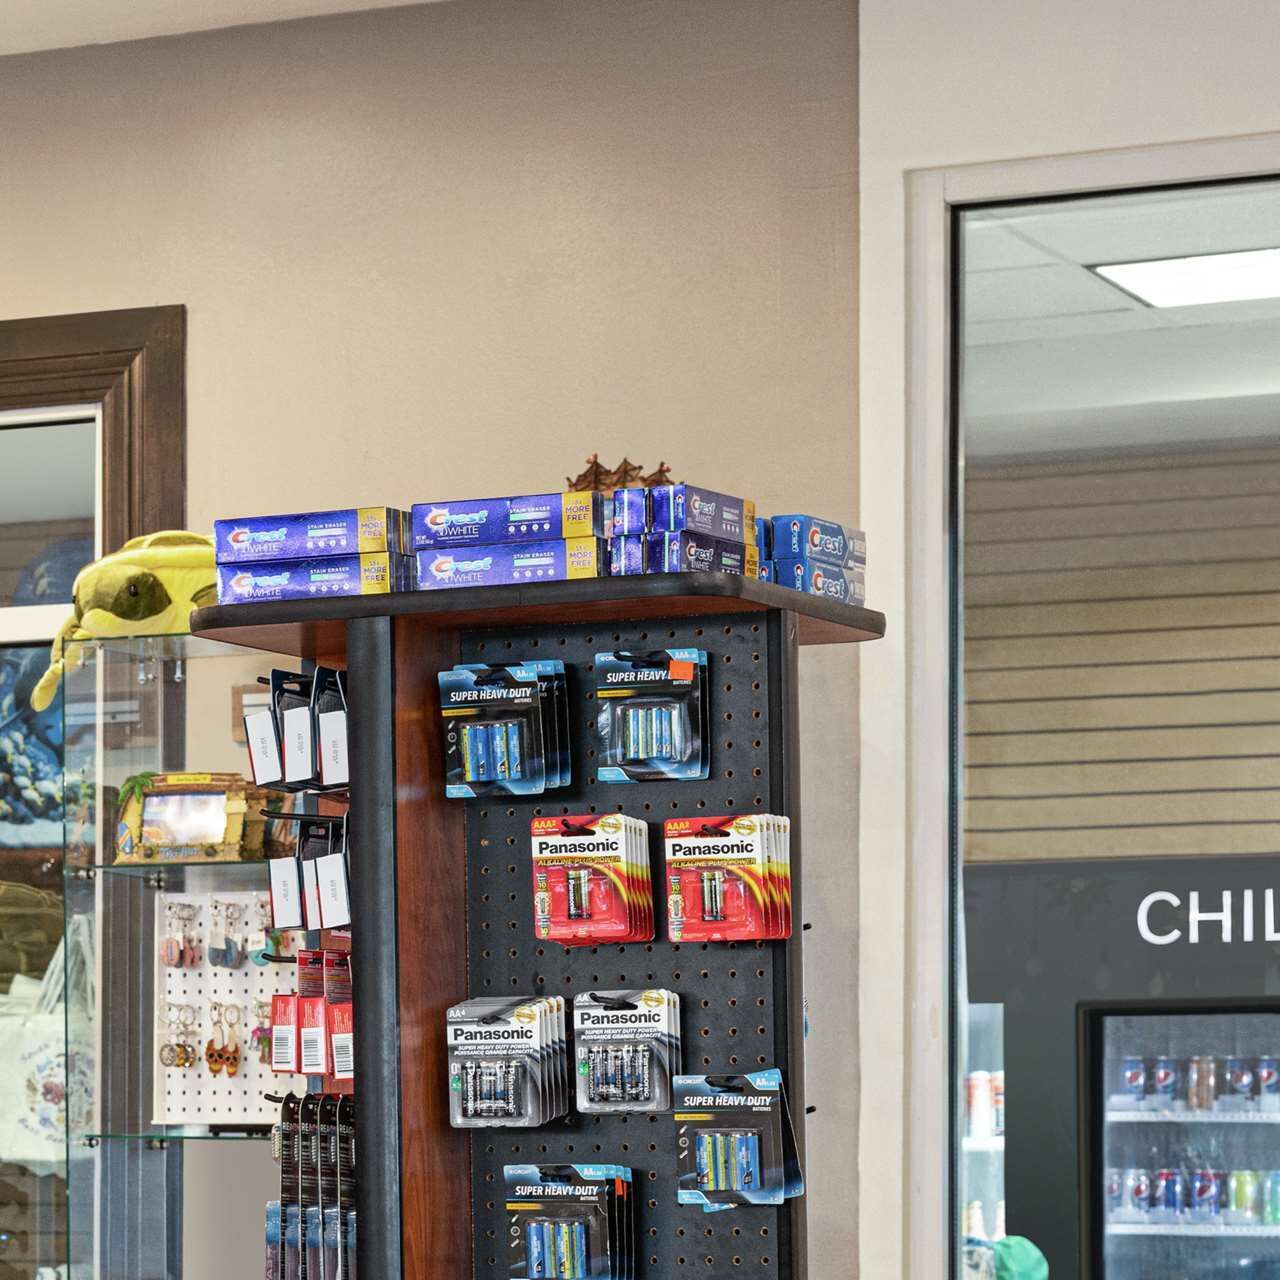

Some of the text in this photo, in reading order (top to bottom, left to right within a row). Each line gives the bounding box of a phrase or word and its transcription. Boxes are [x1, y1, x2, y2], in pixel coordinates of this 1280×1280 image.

[429, 510, 488, 526] Crest
[810, 528, 843, 556] Crest
[433, 557, 492, 572] Crest
[812, 572, 844, 599] Crest
[606, 670, 667, 683] SUPER HEAVY
[450, 688, 531, 702] SUPER HEAVY DUTY
[539, 839, 618, 854] Panasonic
[672, 840, 754, 856] Panasonic
[538, 857, 573, 866] ALKALINE
[580, 1010, 661, 1025] Panasonic
[454, 1026, 533, 1041] Panasonic
[684, 1096, 771, 1106] SUPER HEAVY DUTY
[516, 1186, 598, 1196] SUPER HEAVY DUTY
